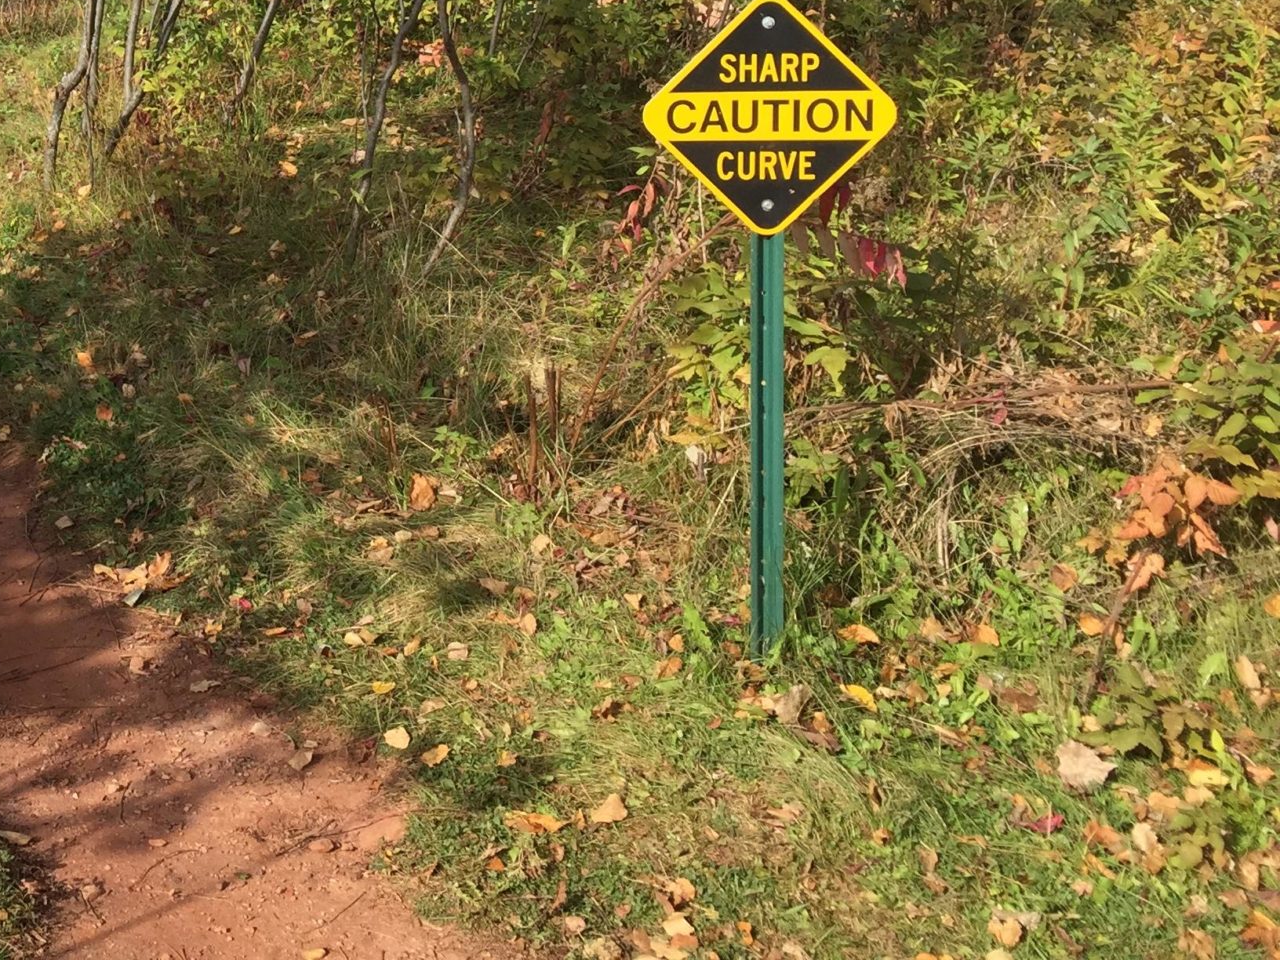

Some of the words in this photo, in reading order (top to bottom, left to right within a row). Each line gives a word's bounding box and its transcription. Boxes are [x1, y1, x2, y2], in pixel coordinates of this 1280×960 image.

[719, 52, 821, 84] SHARP
[666, 98, 874, 134] CAUTION
[716, 150, 817, 181] CURVE
